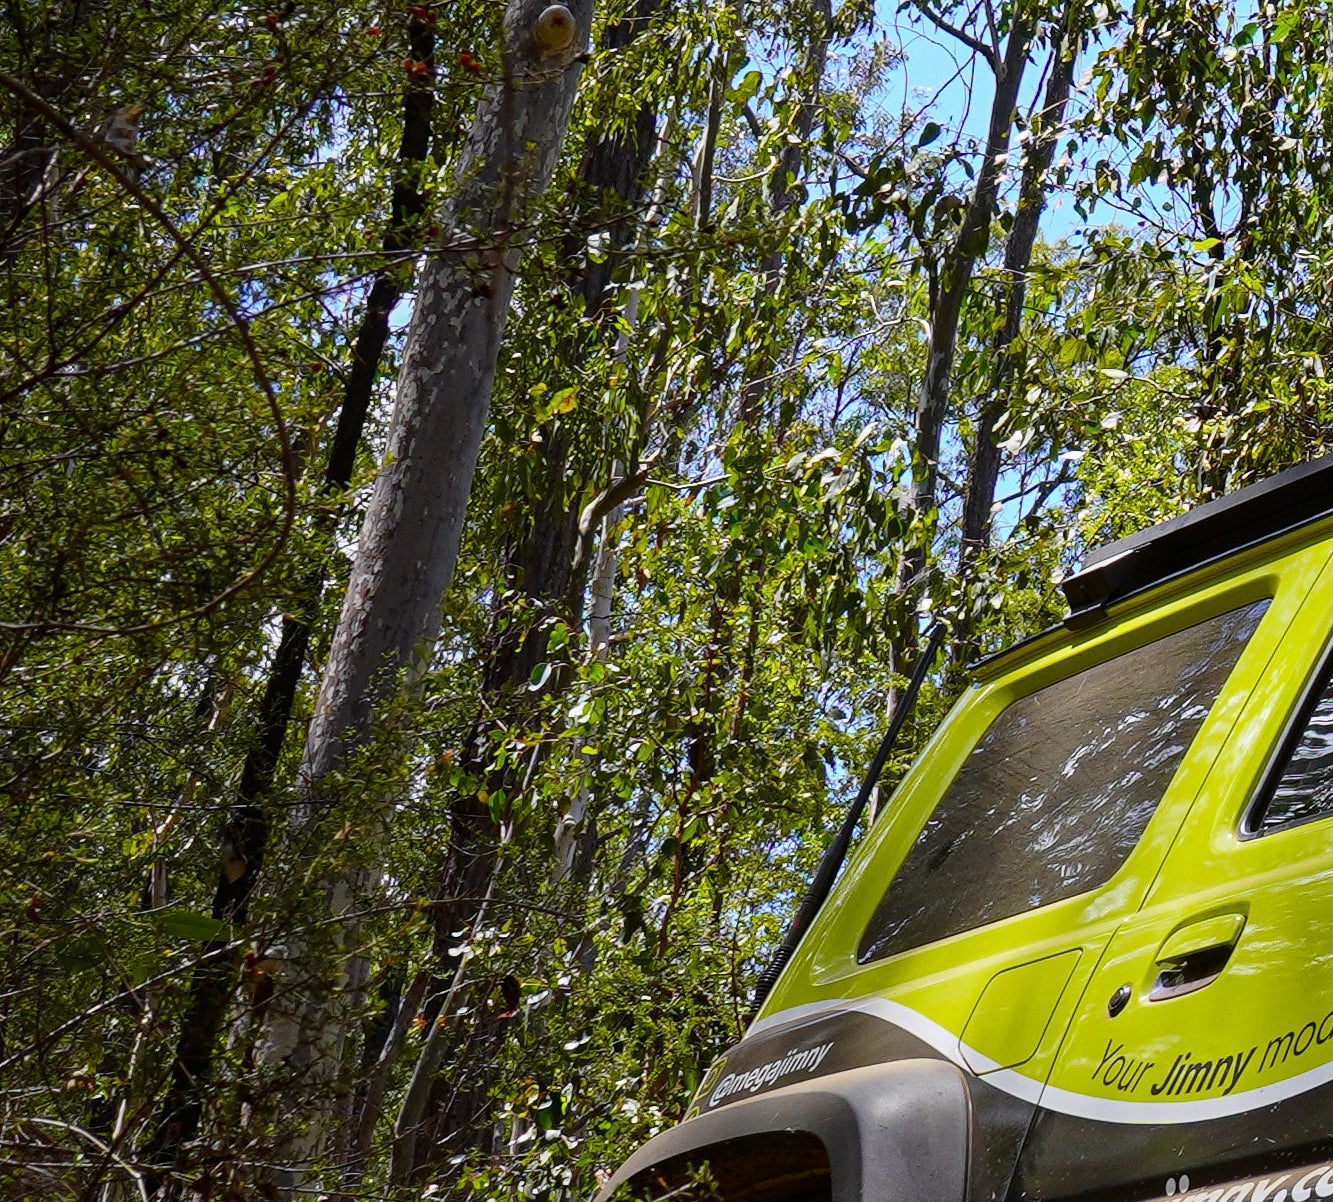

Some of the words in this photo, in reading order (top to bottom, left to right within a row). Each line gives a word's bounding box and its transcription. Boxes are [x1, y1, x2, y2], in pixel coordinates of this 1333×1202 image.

[708, 1041, 834, 1107] @megajimny
[1091, 1038, 1155, 1094] Your
[1150, 1045, 1257, 1096] Jimny
